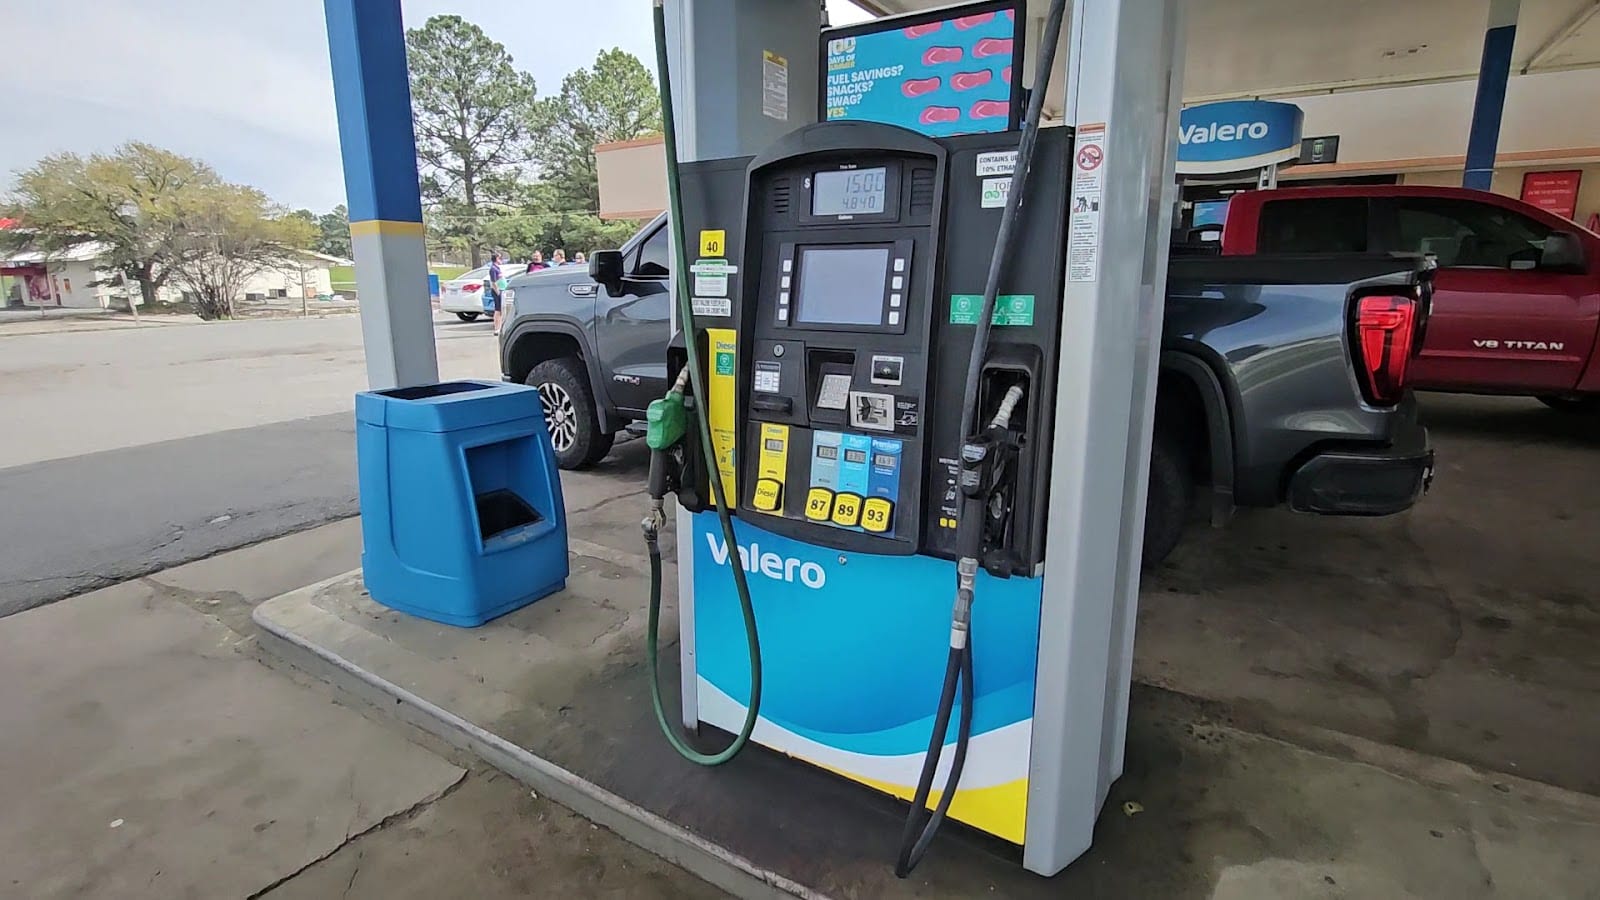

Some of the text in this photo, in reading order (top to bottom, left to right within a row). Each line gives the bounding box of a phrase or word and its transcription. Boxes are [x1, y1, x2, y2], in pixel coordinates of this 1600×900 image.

[827, 65, 904, 85] FUEL SAVINGS?
[827, 81, 874, 96] SNACKS?
[827, 94, 863, 107] SWAG?
[1179, 122, 1268, 144] Valero
[804, 178, 811, 188] $
[706, 241, 718, 253] 40
[716, 341, 735, 351] Diese
[1473, 340, 1564, 350] V8 TITAN
[757, 488, 776, 498] Diesel
[810, 500, 826, 511] 87
[837, 504, 854, 516] 89
[866, 509, 884, 522] 93
